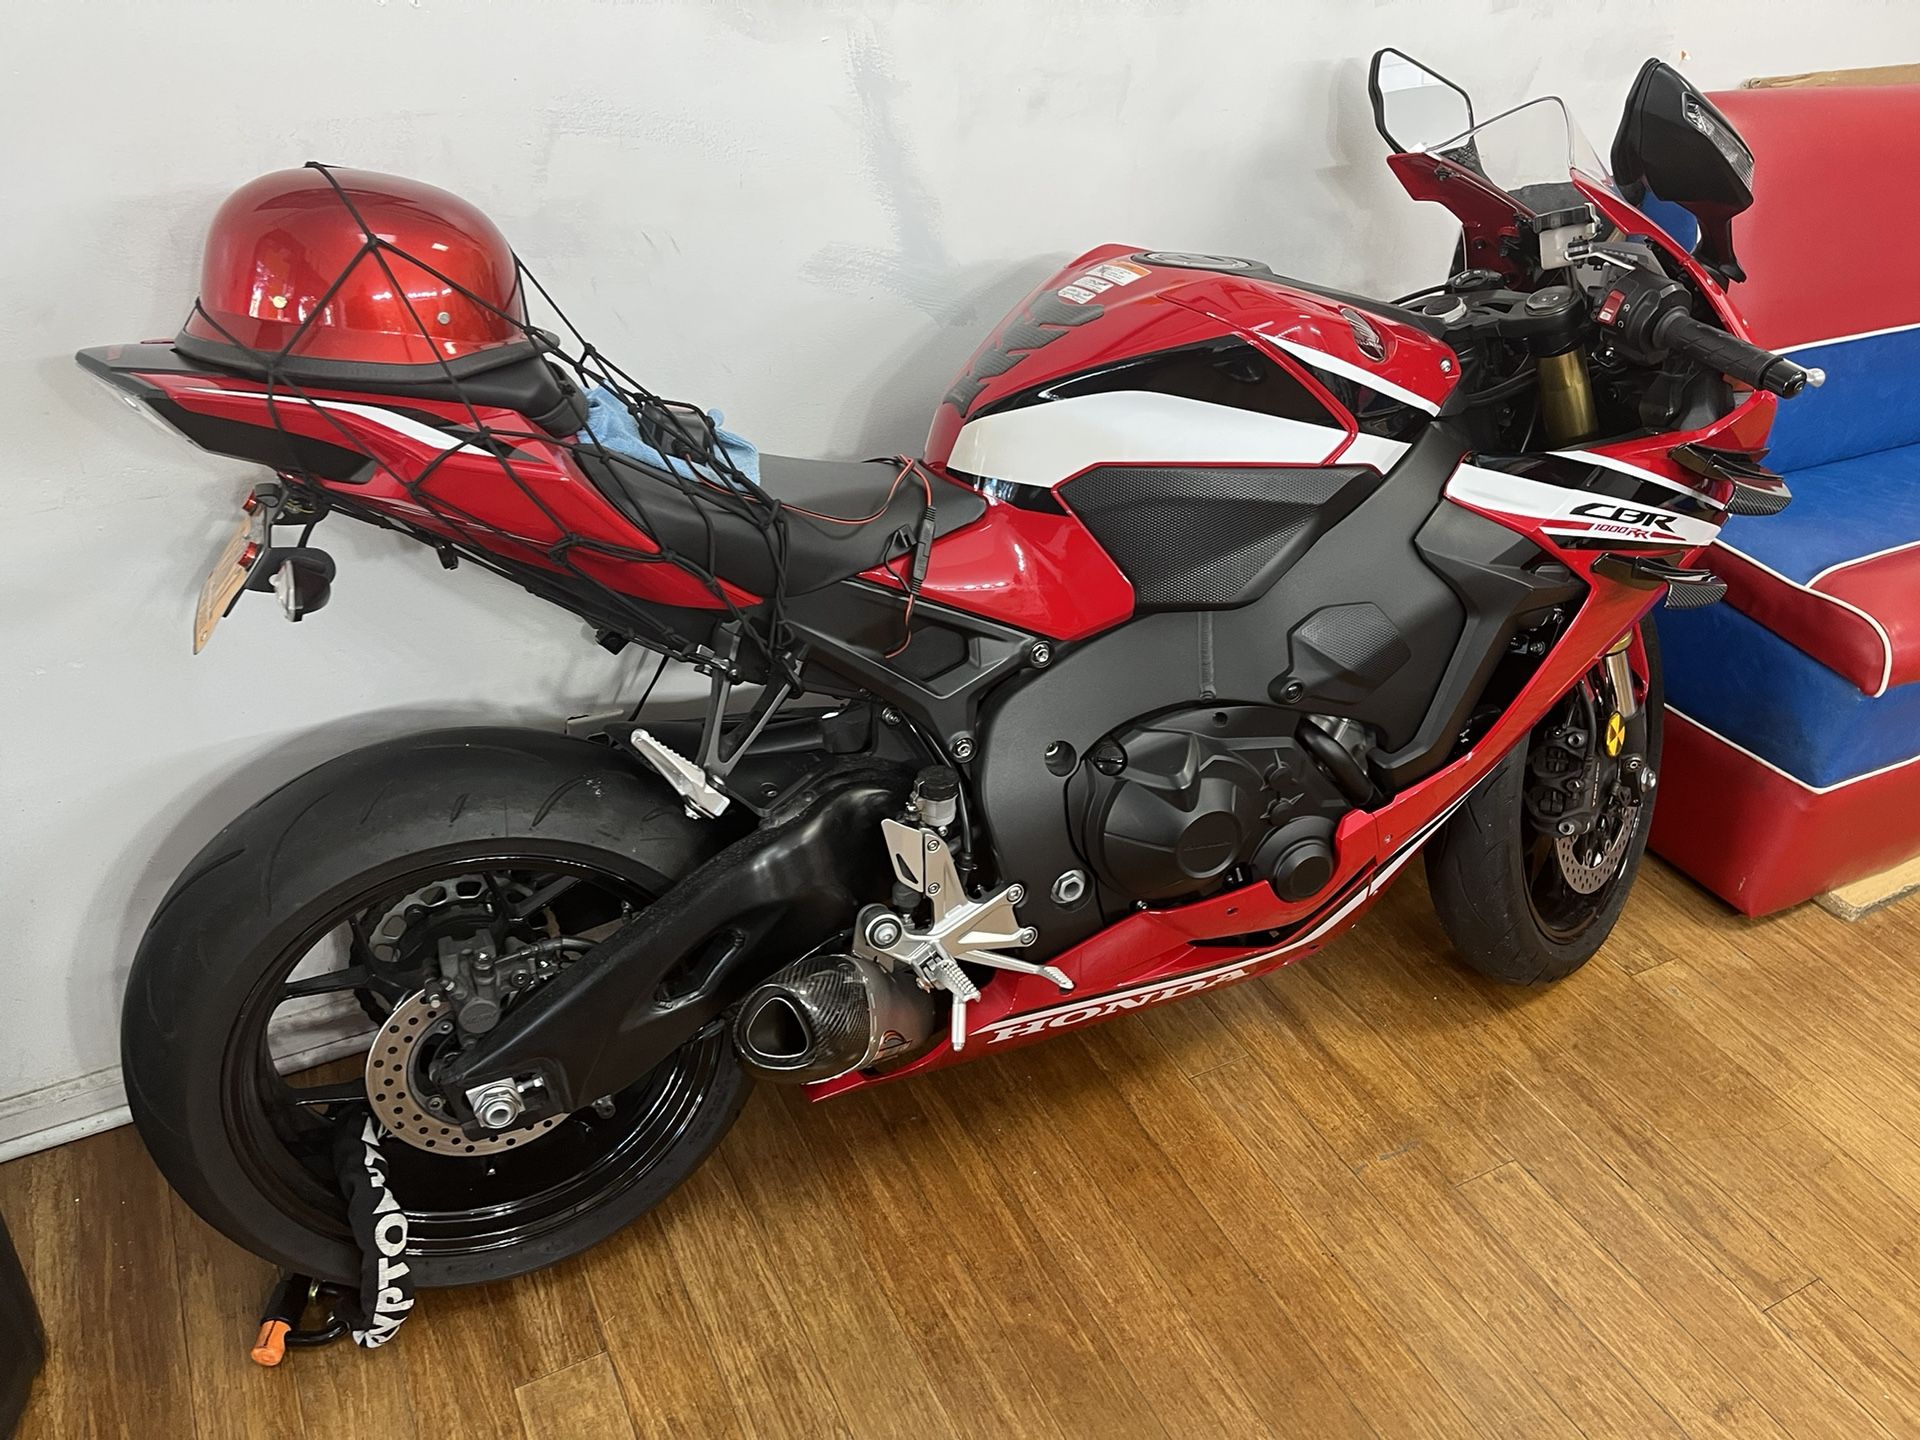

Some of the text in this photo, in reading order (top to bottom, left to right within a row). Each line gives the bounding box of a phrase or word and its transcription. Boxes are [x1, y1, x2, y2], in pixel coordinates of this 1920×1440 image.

[1569, 503, 1678, 533] CBR
[1594, 523, 1651, 540] 1000RR
[987, 968, 1250, 1044] HONDA
